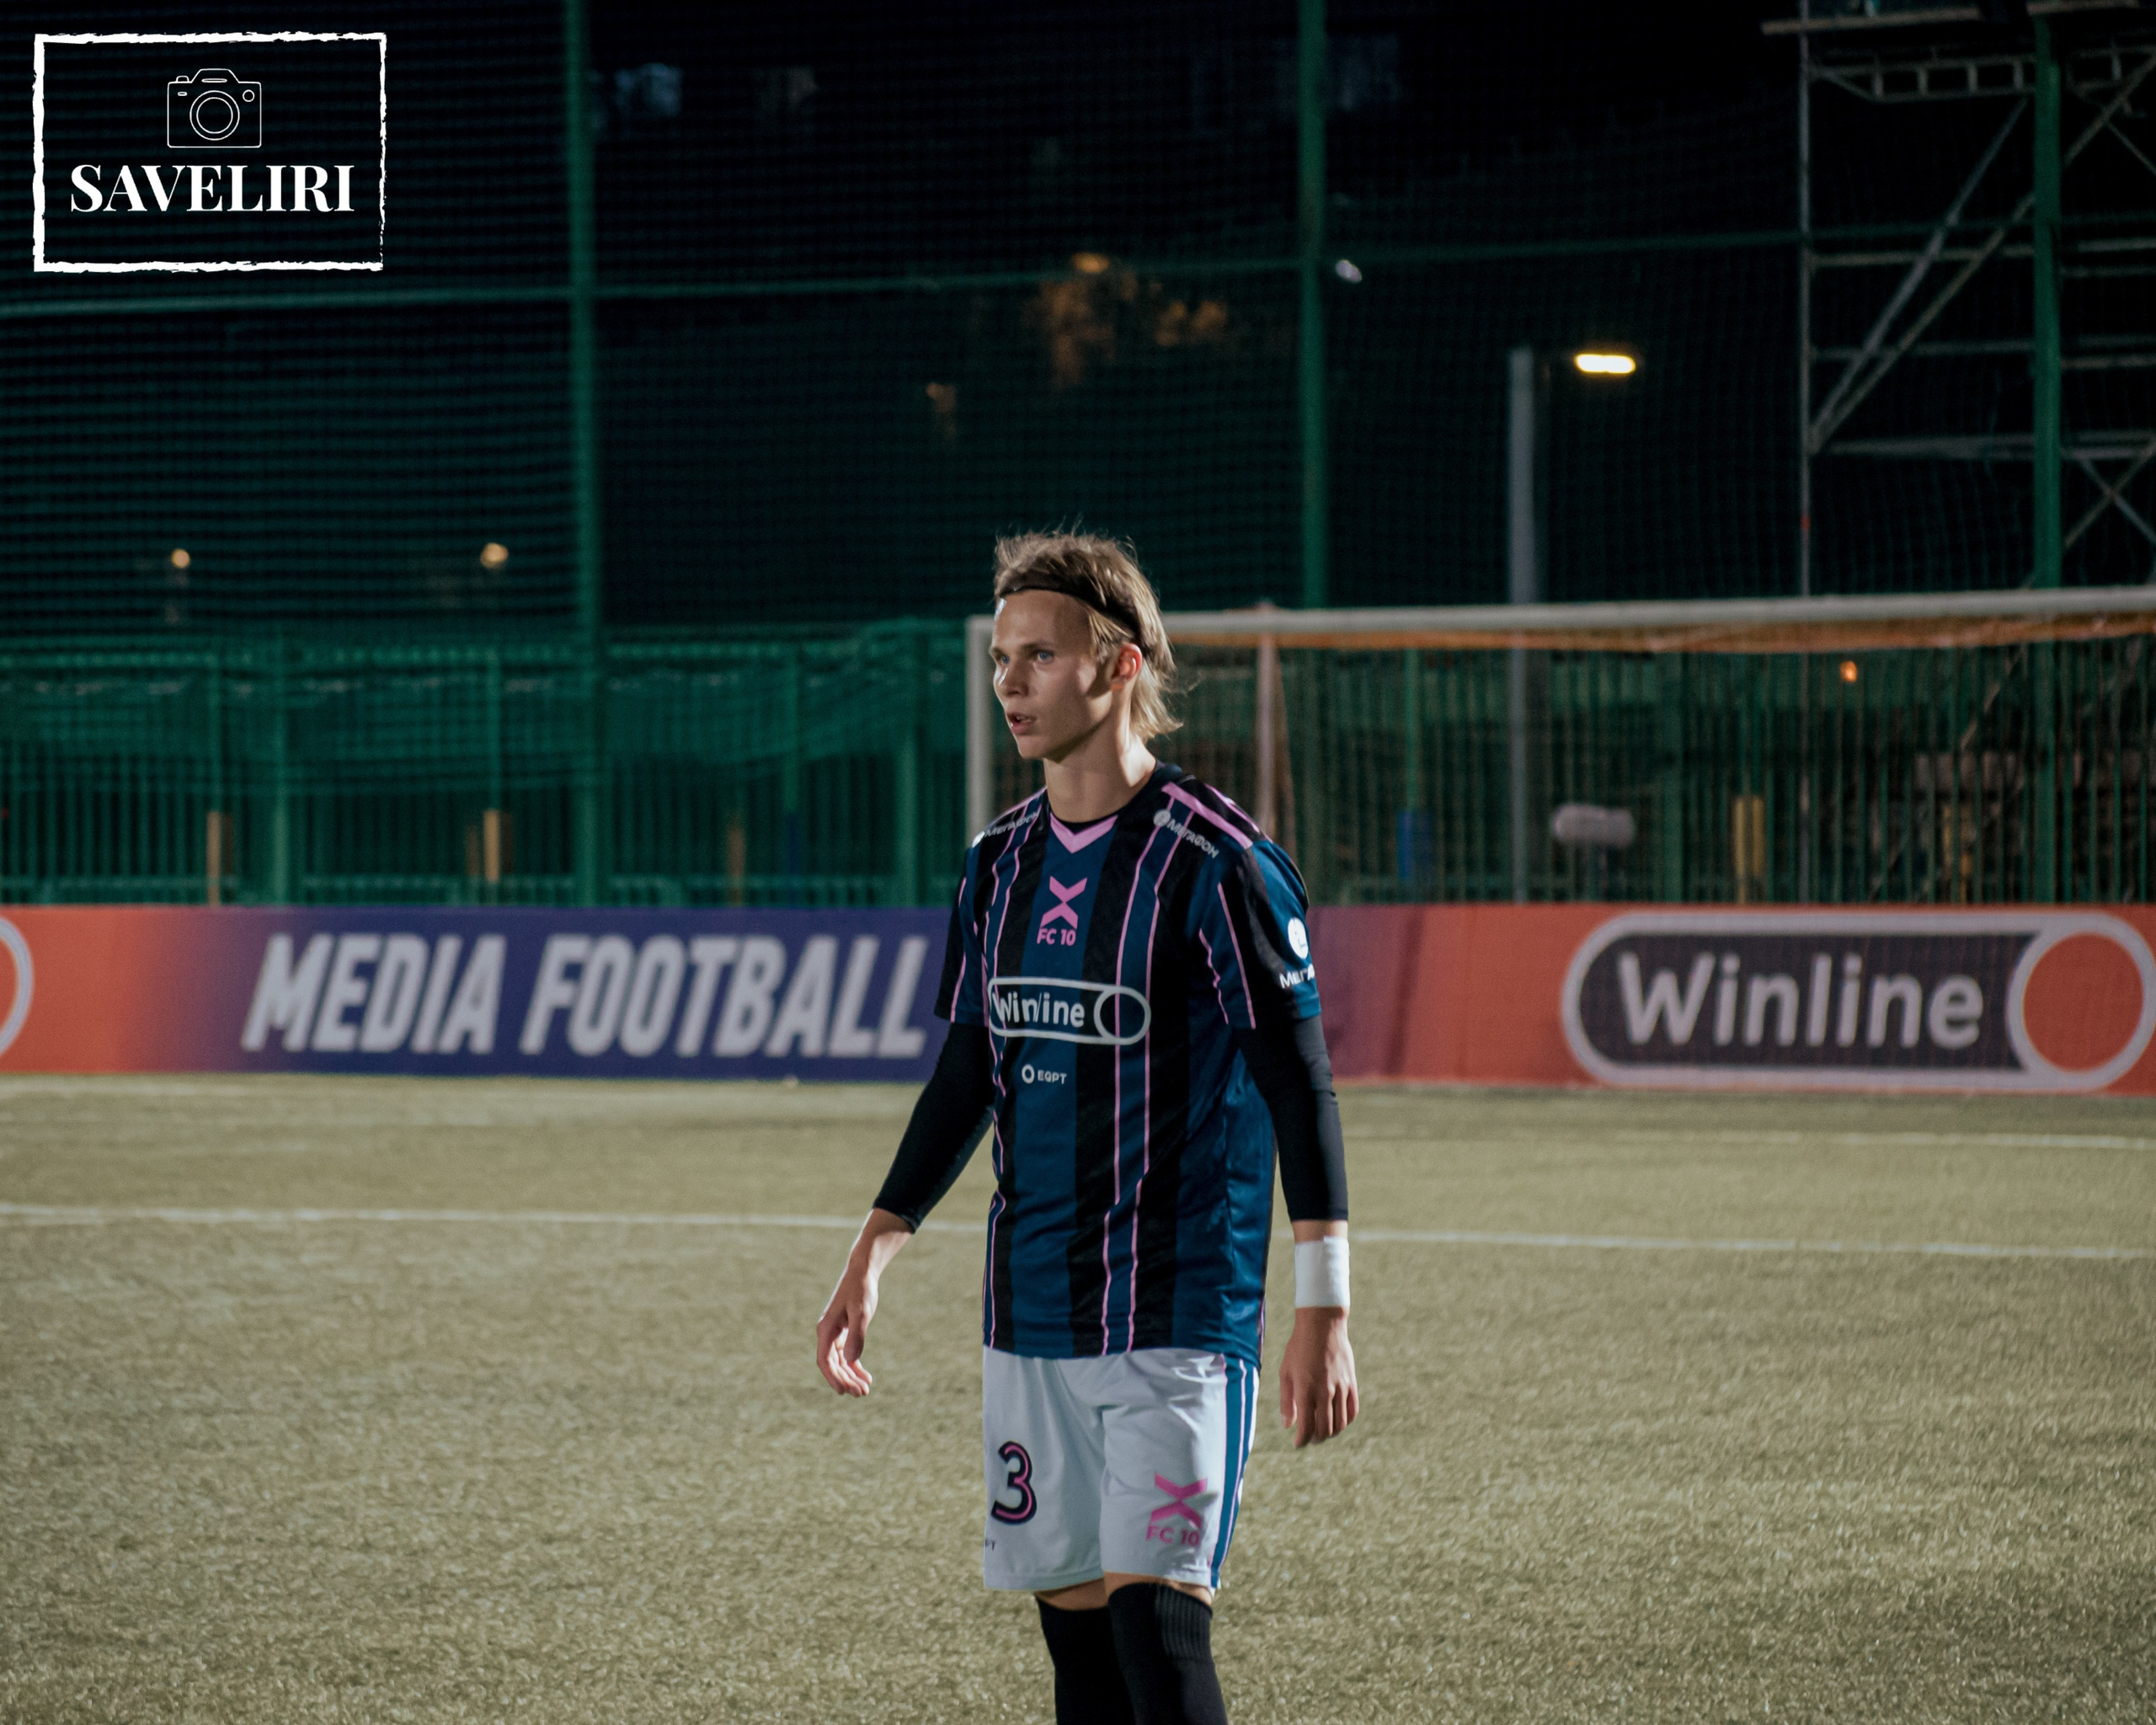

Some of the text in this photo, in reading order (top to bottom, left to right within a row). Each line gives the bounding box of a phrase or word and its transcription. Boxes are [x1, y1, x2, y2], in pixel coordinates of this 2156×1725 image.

[1037, 927, 1076, 946] FC 10
[242, 933, 928, 1058] MEDIA FOOTBALL
[991, 991, 1086, 1028] Winline
[1617, 953, 1983, 1049] Winline
[1037, 1070, 1067, 1085] EQPT
[990, 1440, 1038, 1525] 3
[1146, 1525, 1200, 1546] FC 10
